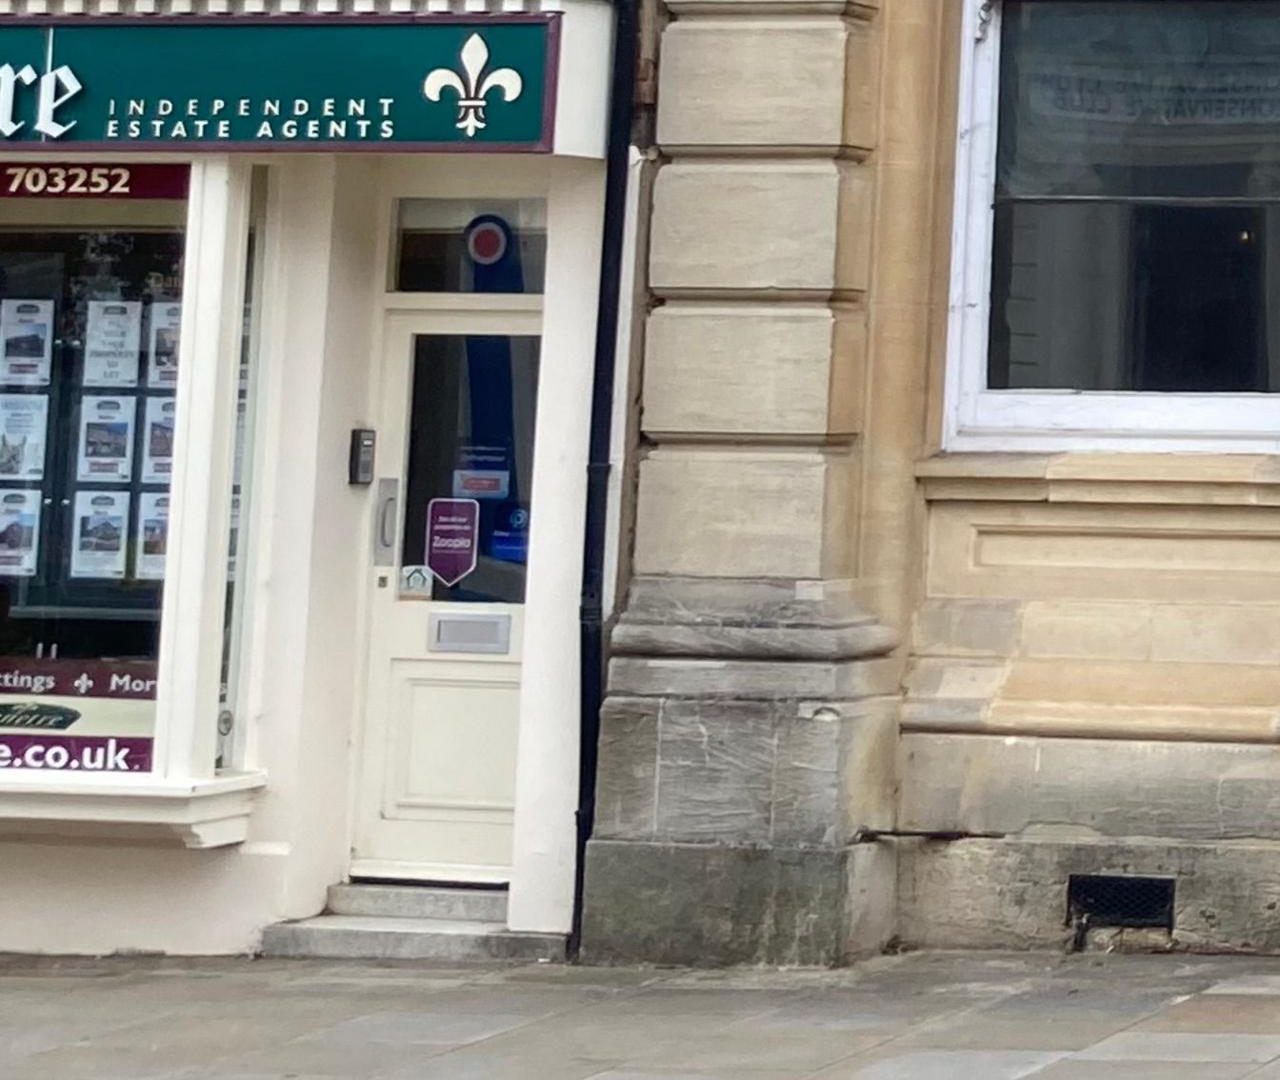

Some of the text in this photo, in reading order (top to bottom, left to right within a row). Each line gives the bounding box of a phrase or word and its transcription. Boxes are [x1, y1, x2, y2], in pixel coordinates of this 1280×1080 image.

[108, 98, 395, 117] INDEPENDENT
[106, 119, 395, 139] ESTATE AGENTS
[7, 167, 131, 194] 703252
